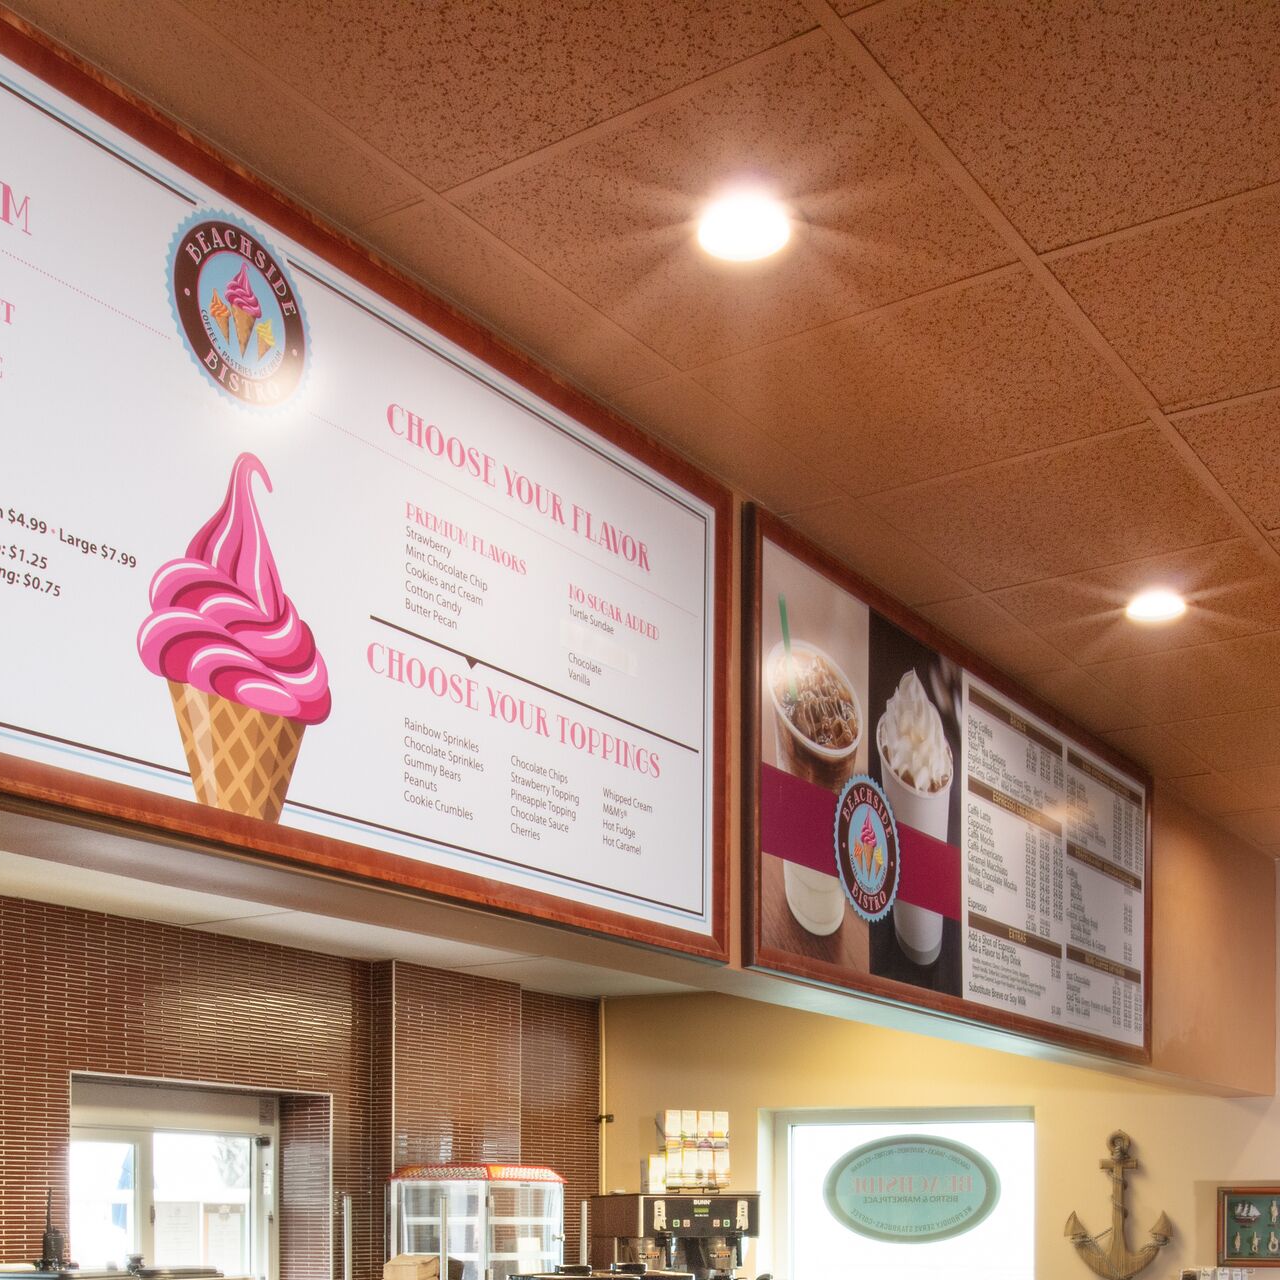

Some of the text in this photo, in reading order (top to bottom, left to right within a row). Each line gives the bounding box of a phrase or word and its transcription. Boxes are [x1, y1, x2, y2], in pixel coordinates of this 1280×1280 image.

[185, 226, 297, 317] BEACHSIDE
[200, 308, 253, 376] COFFEE PASTRIES
[386, 403, 651, 573] CHOOSE YOUR FLAVOR
[7, 508, 48, 535] $4.99
[59, 528, 98, 556] Large
[101, 543, 137, 570] $7.99
[406, 501, 527, 576] PREMIUM FLAVORS
[406, 525, 452, 560] Strawberry
[8, 543, 48, 570] $1.25
[405, 543, 489, 594] Mint Chocolate Chip
[22, 572, 62, 598] $0.75
[405, 562, 484, 607] Cookies and Cream
[405, 580, 463, 617] Cotton Candy
[405, 597, 458, 631] Butter Pecan
[568, 604, 615, 636] Turtle Sundae
[569, 583, 660, 641] NO SUGAR ADDED
[567, 668, 591, 687] Vanilla
[568, 652, 603, 677] Chocolate
[366, 642, 661, 780] CHOOSE YOUR TOPPINGS
[404, 717, 480, 754] Rainbow Sprinkles
[403, 735, 485, 773] Chocolate Sprinkles
[403, 753, 462, 783] Gummy Bears
[510, 755, 569, 786] Chocolate Chips
[404, 771, 438, 793] Peanuts
[510, 771, 580, 808] Strawberry Topping
[403, 790, 474, 822] Cookie Crumbles
[510, 788, 577, 823] Pineapple Topping
[602, 787, 653, 814] Whipped Cream
[842, 786, 894, 839] BEACHSIDE
[510, 805, 570, 834] Chocolate Sauce
[510, 822, 541, 842] Cherries
[602, 819, 636, 840] Hot Fudge
[602, 834, 642, 856] Hot Caramel
[851, 881, 888, 911] BISTRO
